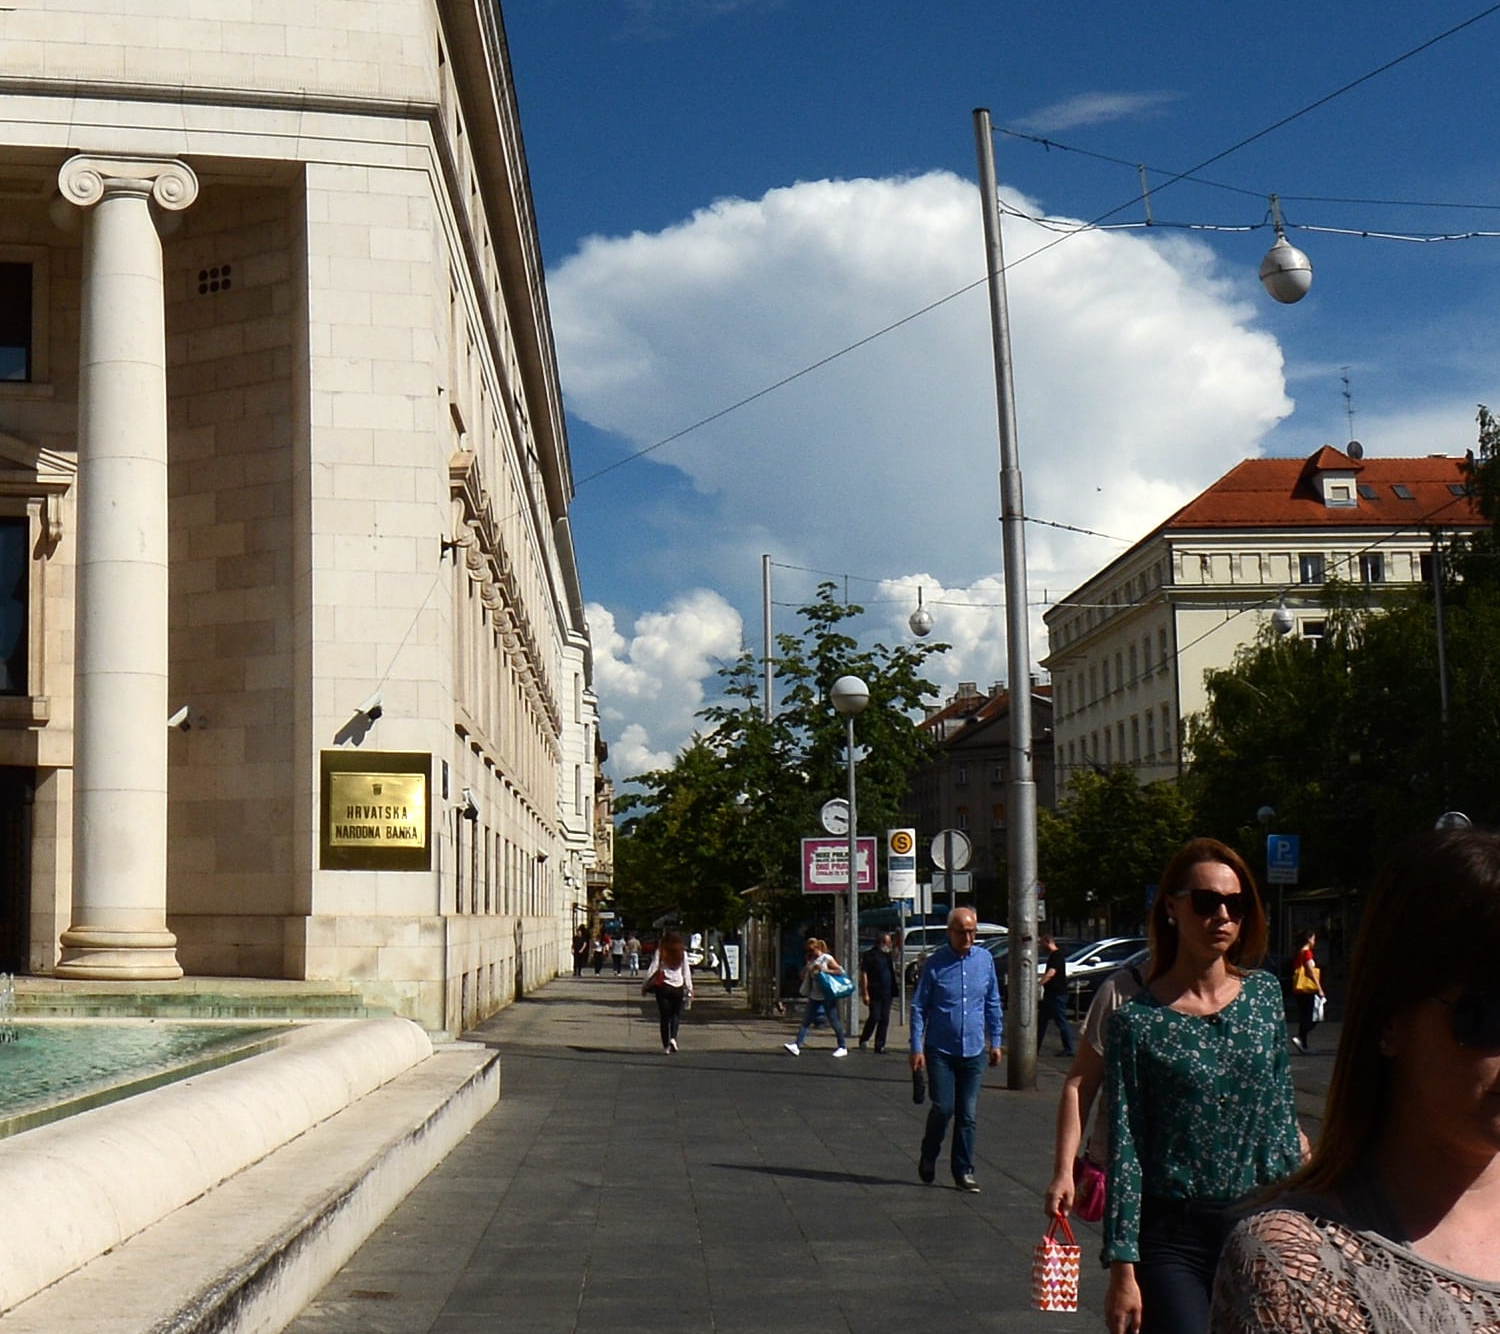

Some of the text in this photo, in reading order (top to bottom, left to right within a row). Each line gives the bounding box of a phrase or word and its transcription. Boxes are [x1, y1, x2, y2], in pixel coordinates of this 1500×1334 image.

[347, 806, 407, 819] HRVATSKA
[336, 825, 418, 839] NARODNA BANKA
[1277, 840, 1290, 860] P
